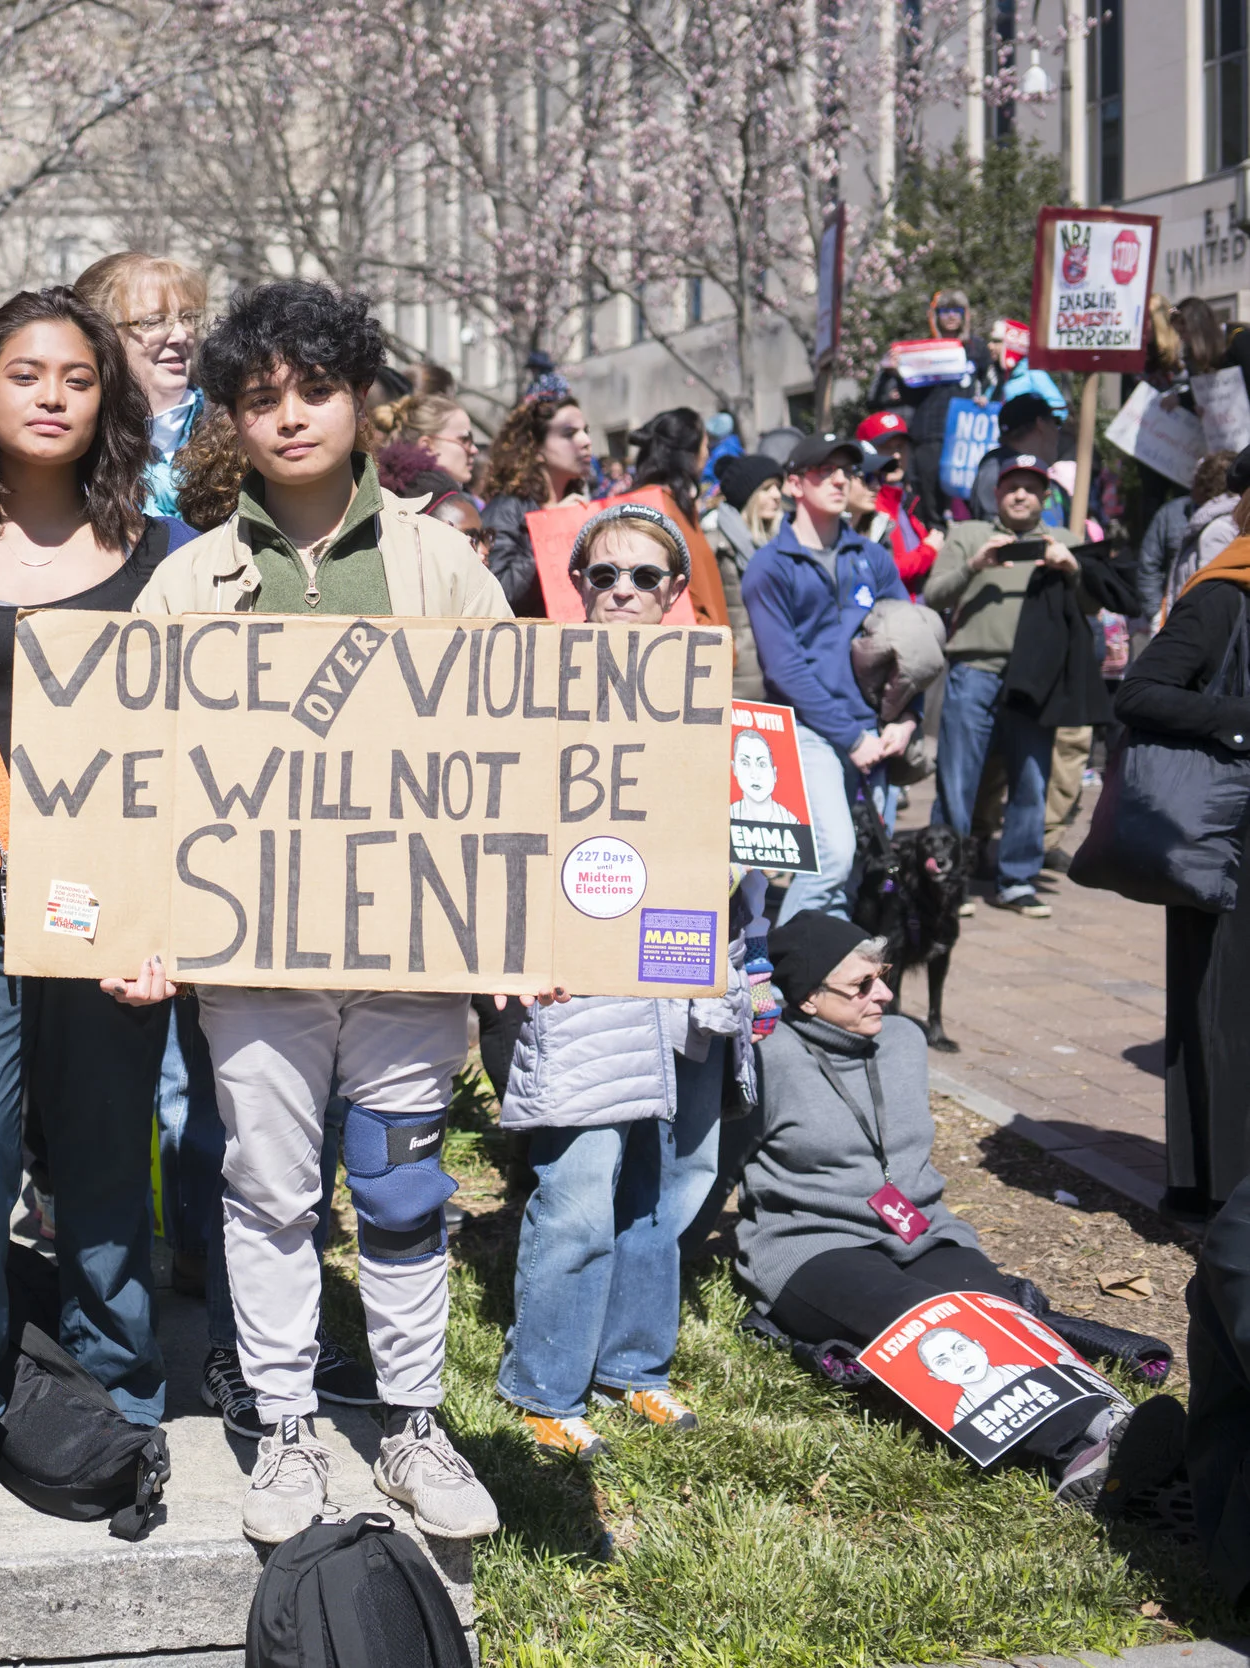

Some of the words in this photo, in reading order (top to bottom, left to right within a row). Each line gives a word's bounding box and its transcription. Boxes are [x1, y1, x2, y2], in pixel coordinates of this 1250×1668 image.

[1060, 223, 1092, 256] NRA
[1166, 233, 1246, 280] UNITED
[1057, 311, 1122, 330] DOMESTIC
[1056, 327, 1132, 346] TERRORISM
[622, 504, 661, 521] Anxiety
[16, 619, 292, 713] VOICE
[303, 626, 378, 722] OVER
[391, 622, 724, 726] VIOLENCE
[753, 711, 785, 733] WITH
[10, 743, 164, 819] WE
[188, 744, 372, 821] WILL
[389, 748, 521, 821] NOT
[559, 742, 648, 823] BE
[730, 825, 800, 851] EMMA
[576, 851, 600, 862] 227
[603, 851, 634, 865] Days
[734, 847, 755, 861] WE
[755, 848, 784, 863] CALL
[783, 850, 801, 865] BS
[578, 871, 632, 883] Midterm
[575, 883, 634, 895] Elections
[176, 823, 552, 975] SILENT
[53, 915, 73, 925] HEAL
[54, 921, 87, 931] AMERICA
[644, 930, 710, 946] MADRE
[643, 955, 710, 964] www.madre.org
[875, 1349, 891, 1364] I
[883, 1320, 927, 1358] STAND
[919, 1300, 961, 1326] WITH
[969, 1378, 1052, 1437] EMMA
[987, 1426, 1008, 1444] WE
[1006, 1402, 1043, 1432] CALL
[1040, 1388, 1060, 1408] BS
